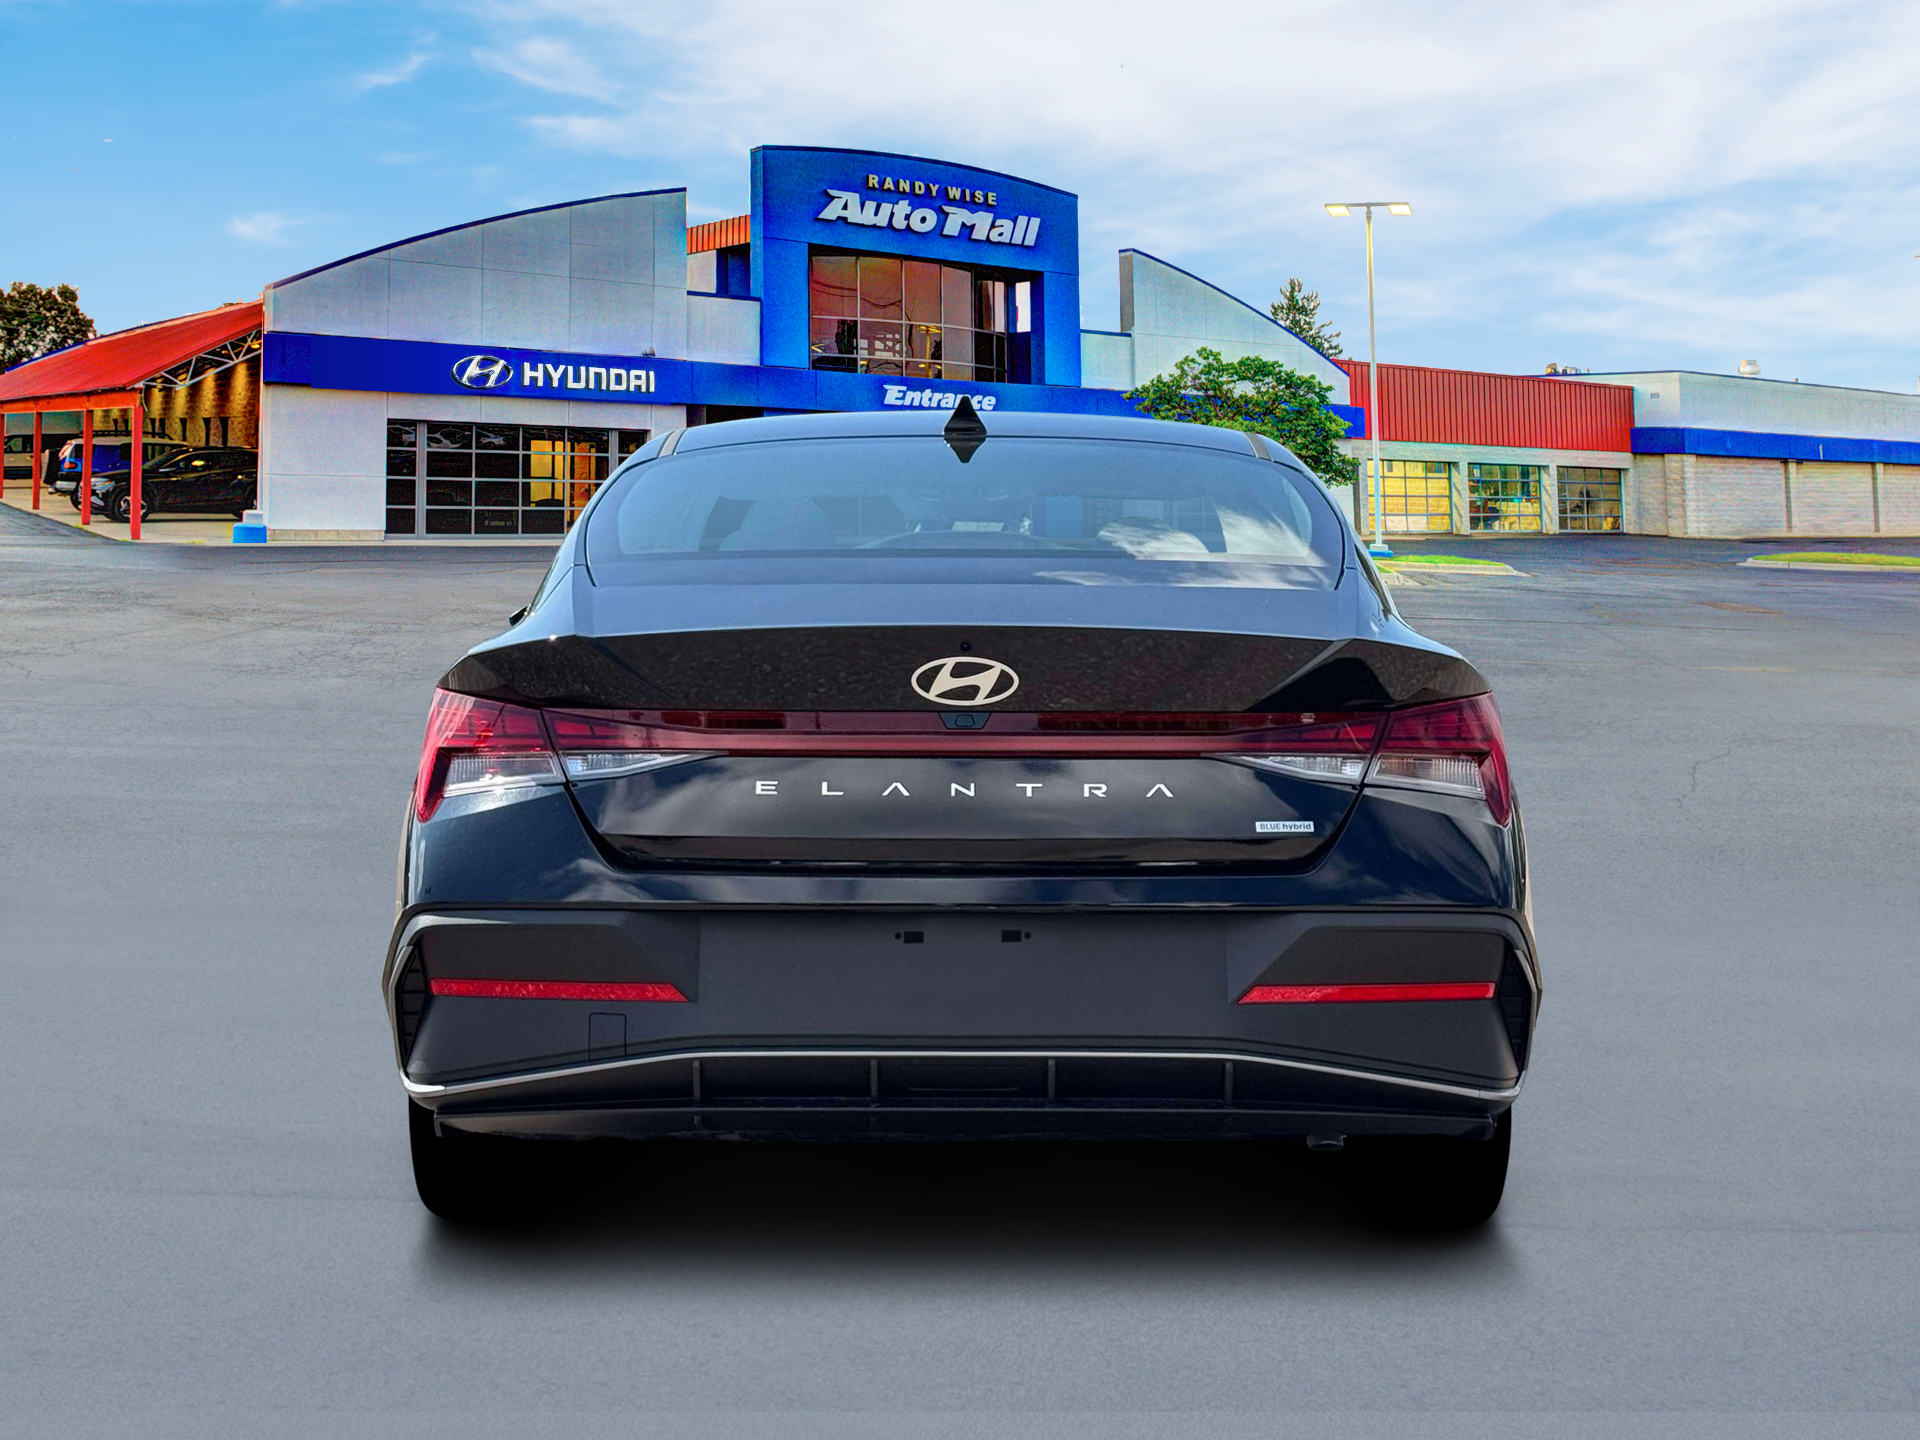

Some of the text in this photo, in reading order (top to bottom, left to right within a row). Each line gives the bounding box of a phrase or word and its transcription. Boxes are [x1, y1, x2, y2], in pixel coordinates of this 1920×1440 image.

[866, 174, 997, 206] RANDY WISE
[816, 188, 1041, 247] Auto Mall
[522, 361, 656, 393] HYUNDAI
[754, 780, 1175, 798] ELANTRA
[1259, 822, 1312, 831] BLUE hybrid
